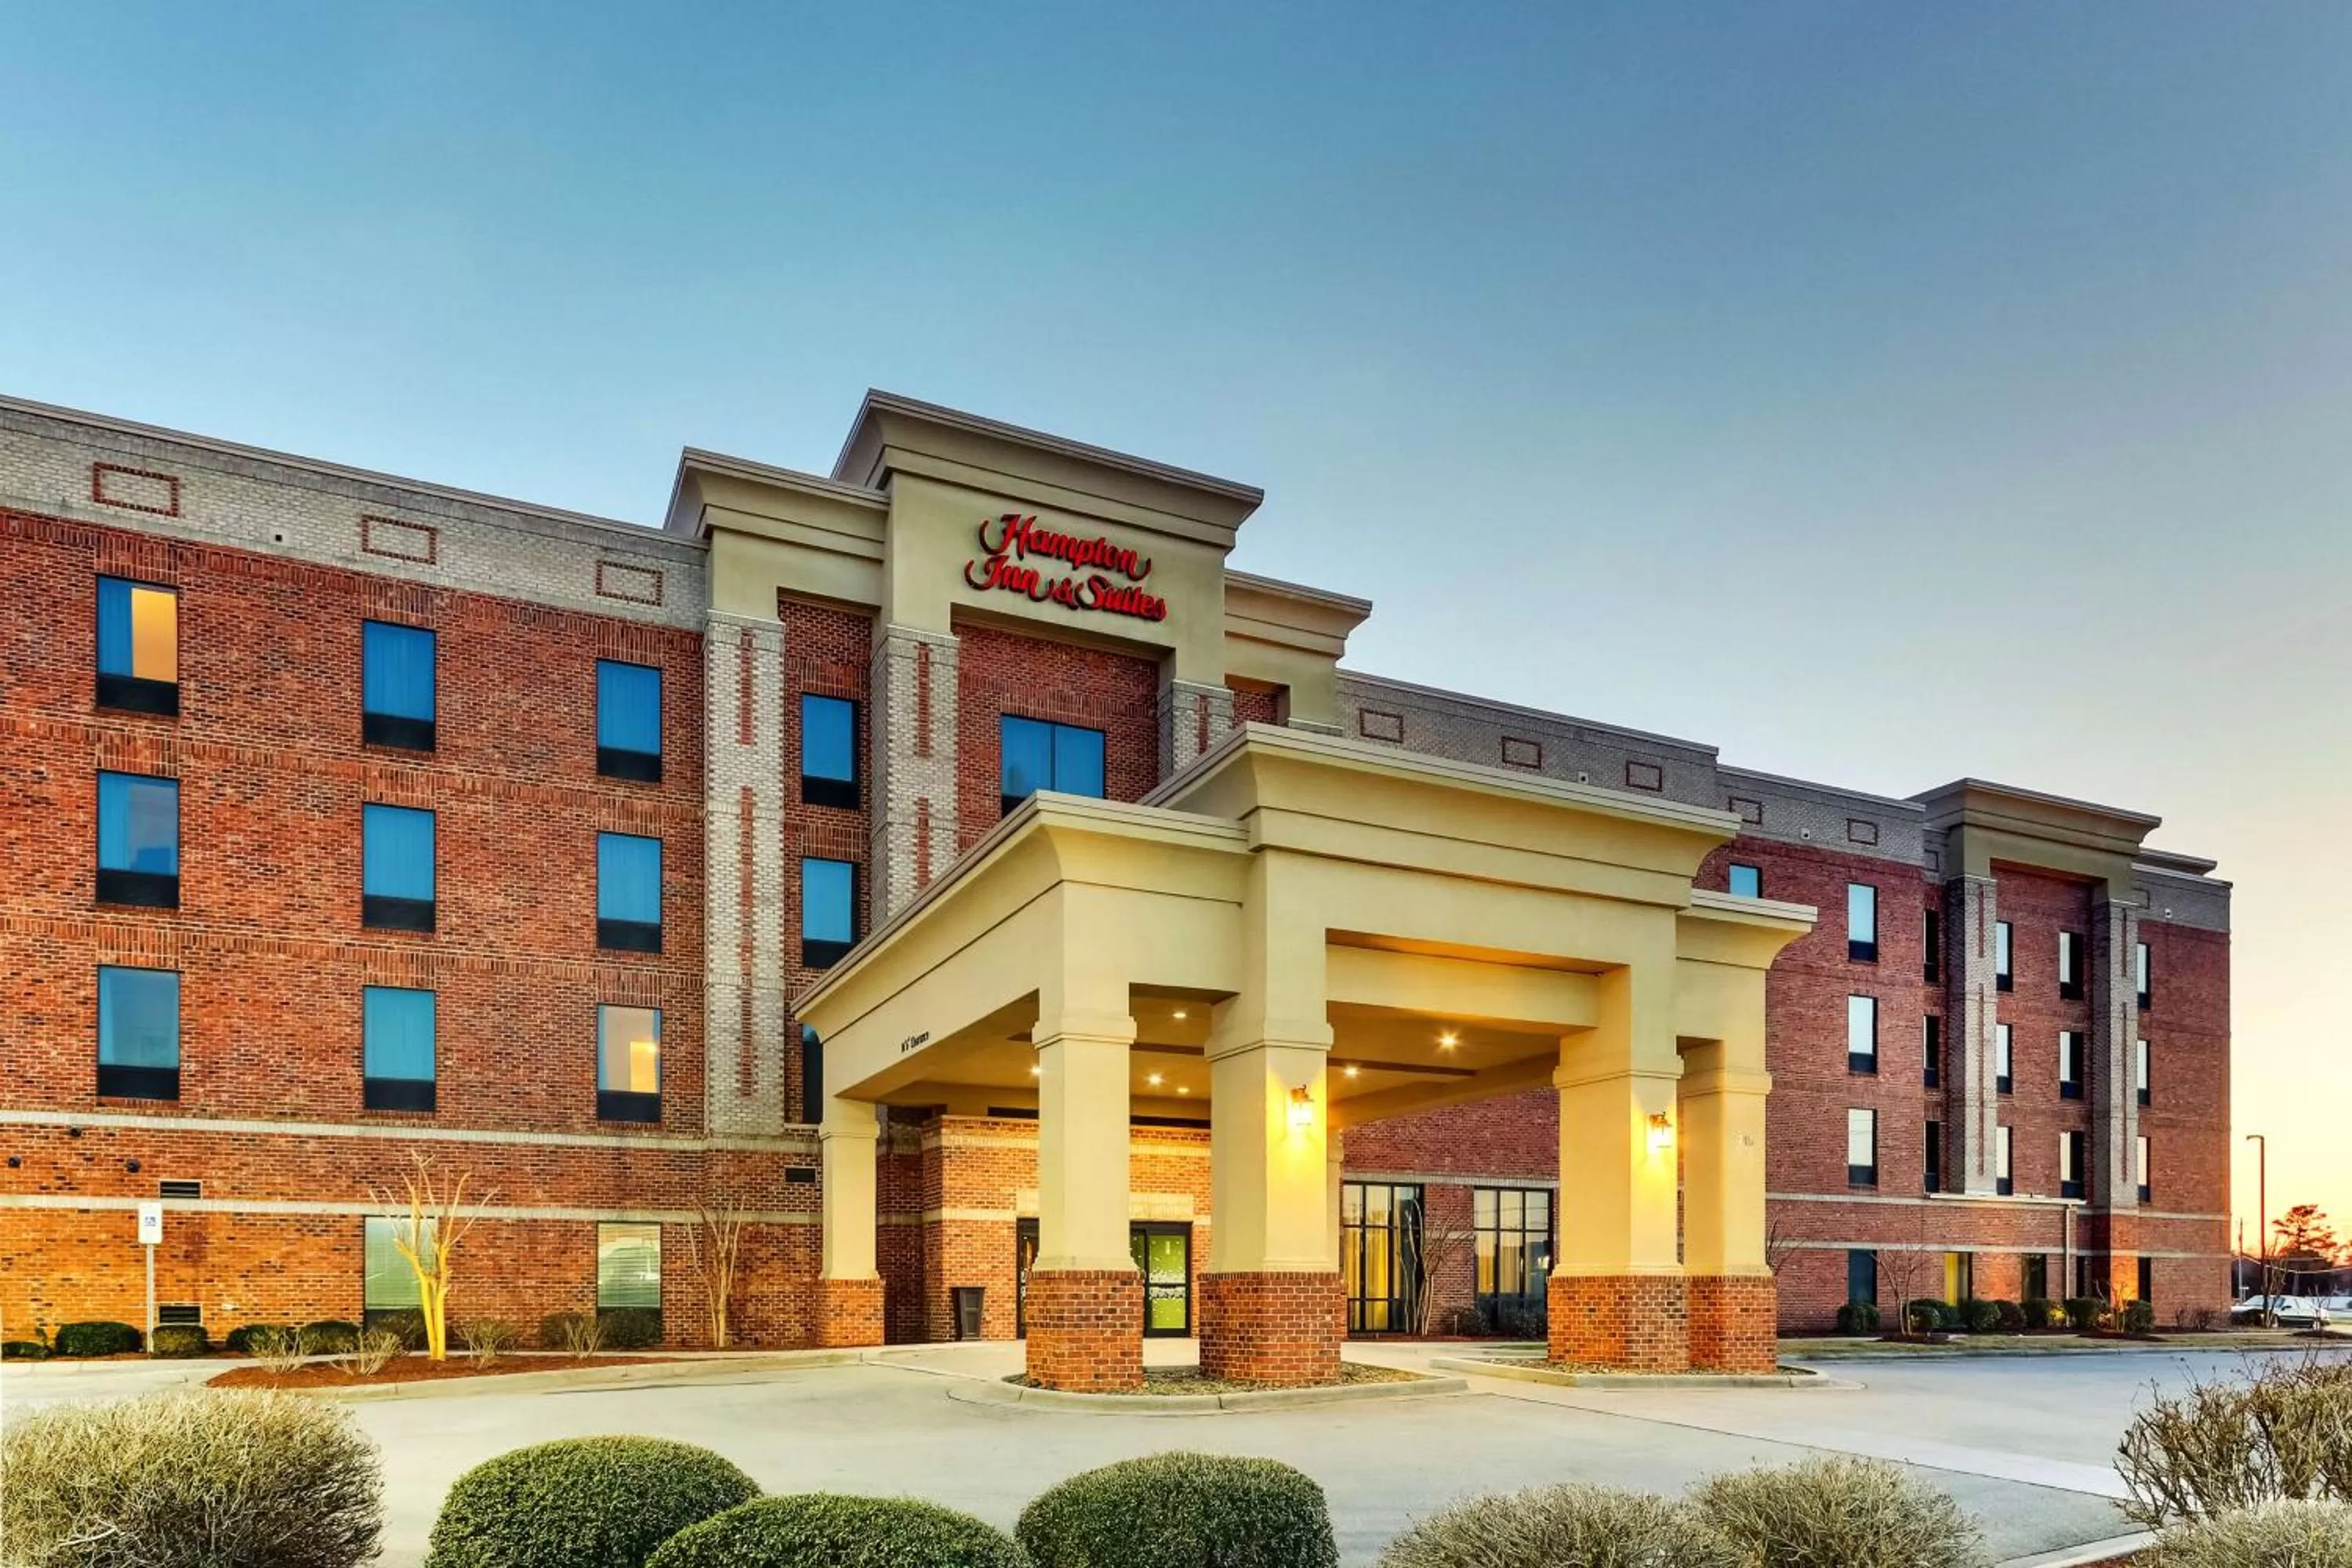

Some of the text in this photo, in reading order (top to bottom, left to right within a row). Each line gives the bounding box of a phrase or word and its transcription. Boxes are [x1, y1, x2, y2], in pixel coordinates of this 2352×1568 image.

[978, 514, 1152, 582] Hampton
[964, 554, 1167, 622] Inn & Suites
